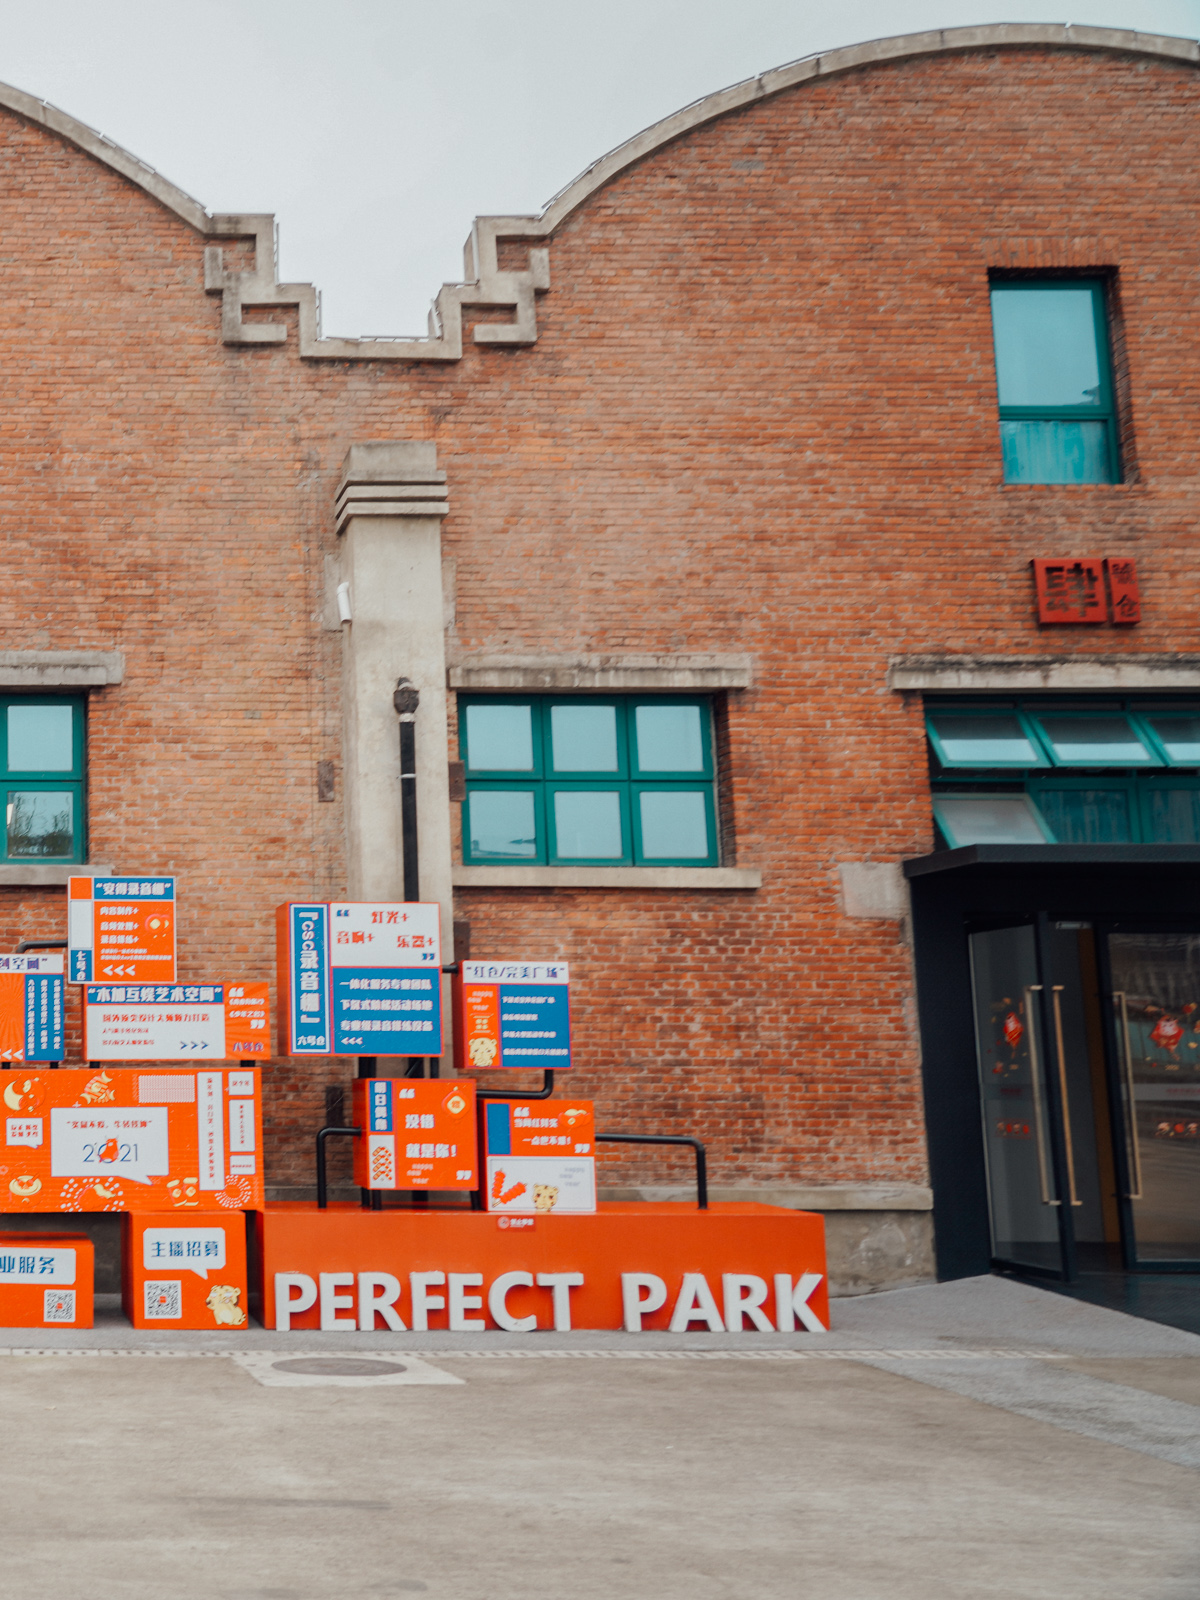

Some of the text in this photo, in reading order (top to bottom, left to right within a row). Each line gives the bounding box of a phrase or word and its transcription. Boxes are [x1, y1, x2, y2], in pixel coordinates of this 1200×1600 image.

[297, 1035, 326, 1046] 六号仓
[82, 1137, 138, 1163] 2021
[151, 1241, 218, 1257] 主播招募
[274, 1270, 827, 1332] PERFECT PARK
